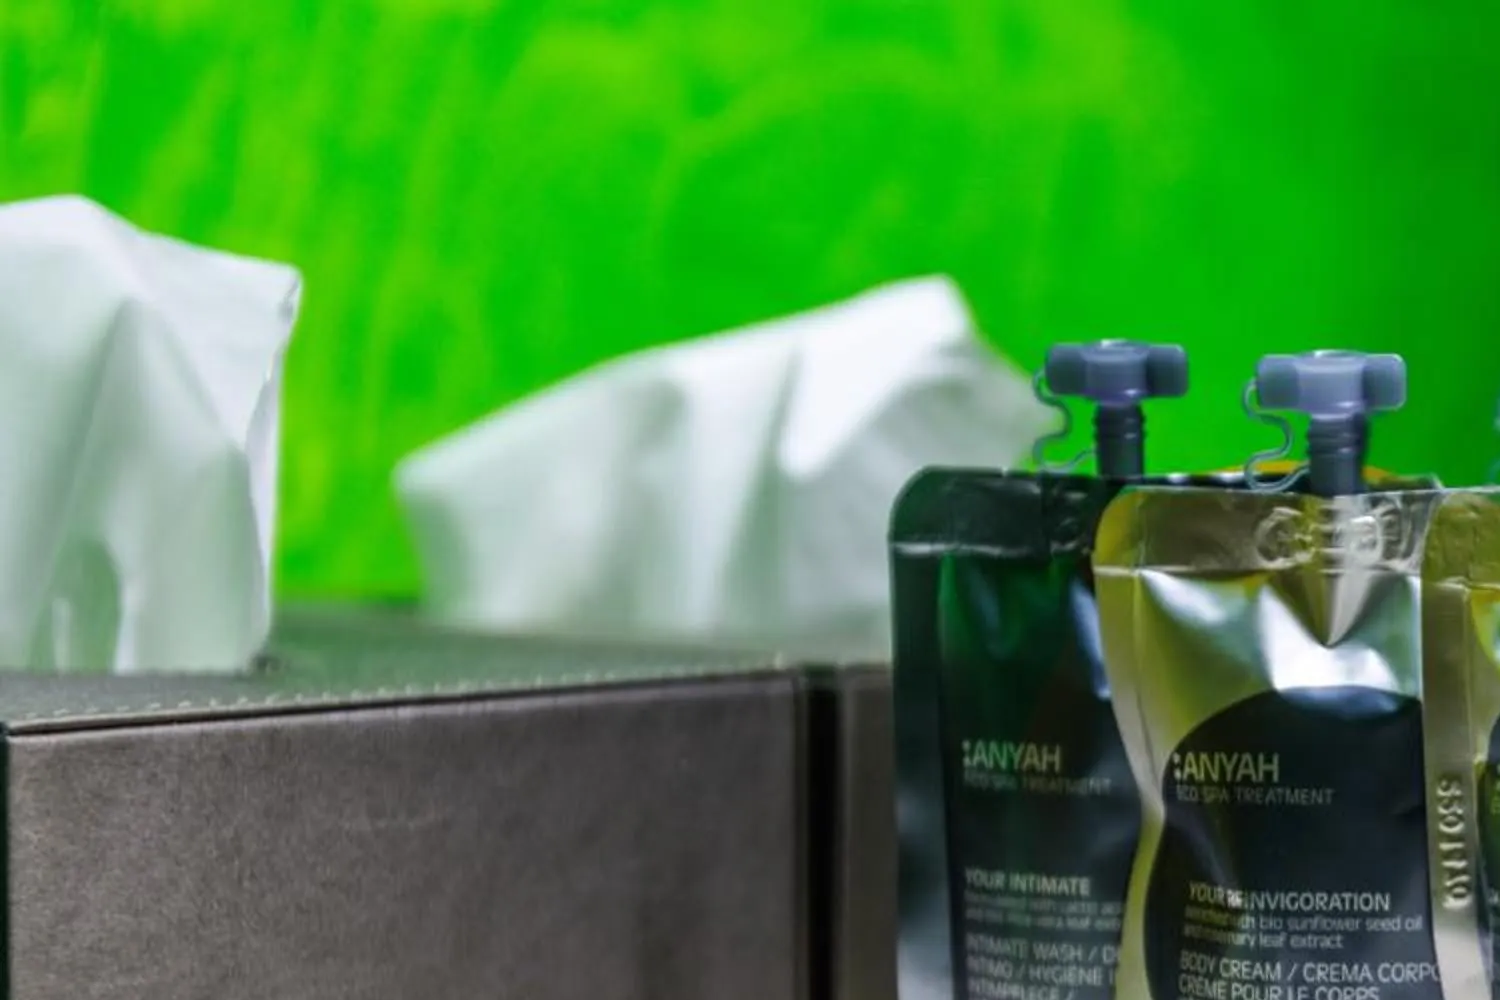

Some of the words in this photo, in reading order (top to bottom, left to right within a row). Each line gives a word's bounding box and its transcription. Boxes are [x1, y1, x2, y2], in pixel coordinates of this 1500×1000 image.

[1234, 786, 1336, 806] TREATMENT
[965, 867, 1006, 890] YOUR
[1009, 873, 1091, 897] INTIMATE
[1364, 916, 1401, 930] seed
[1290, 933, 1344, 949] extract
[1219, 957, 1282, 981] CREAM
[1302, 960, 1374, 983] CREMA
